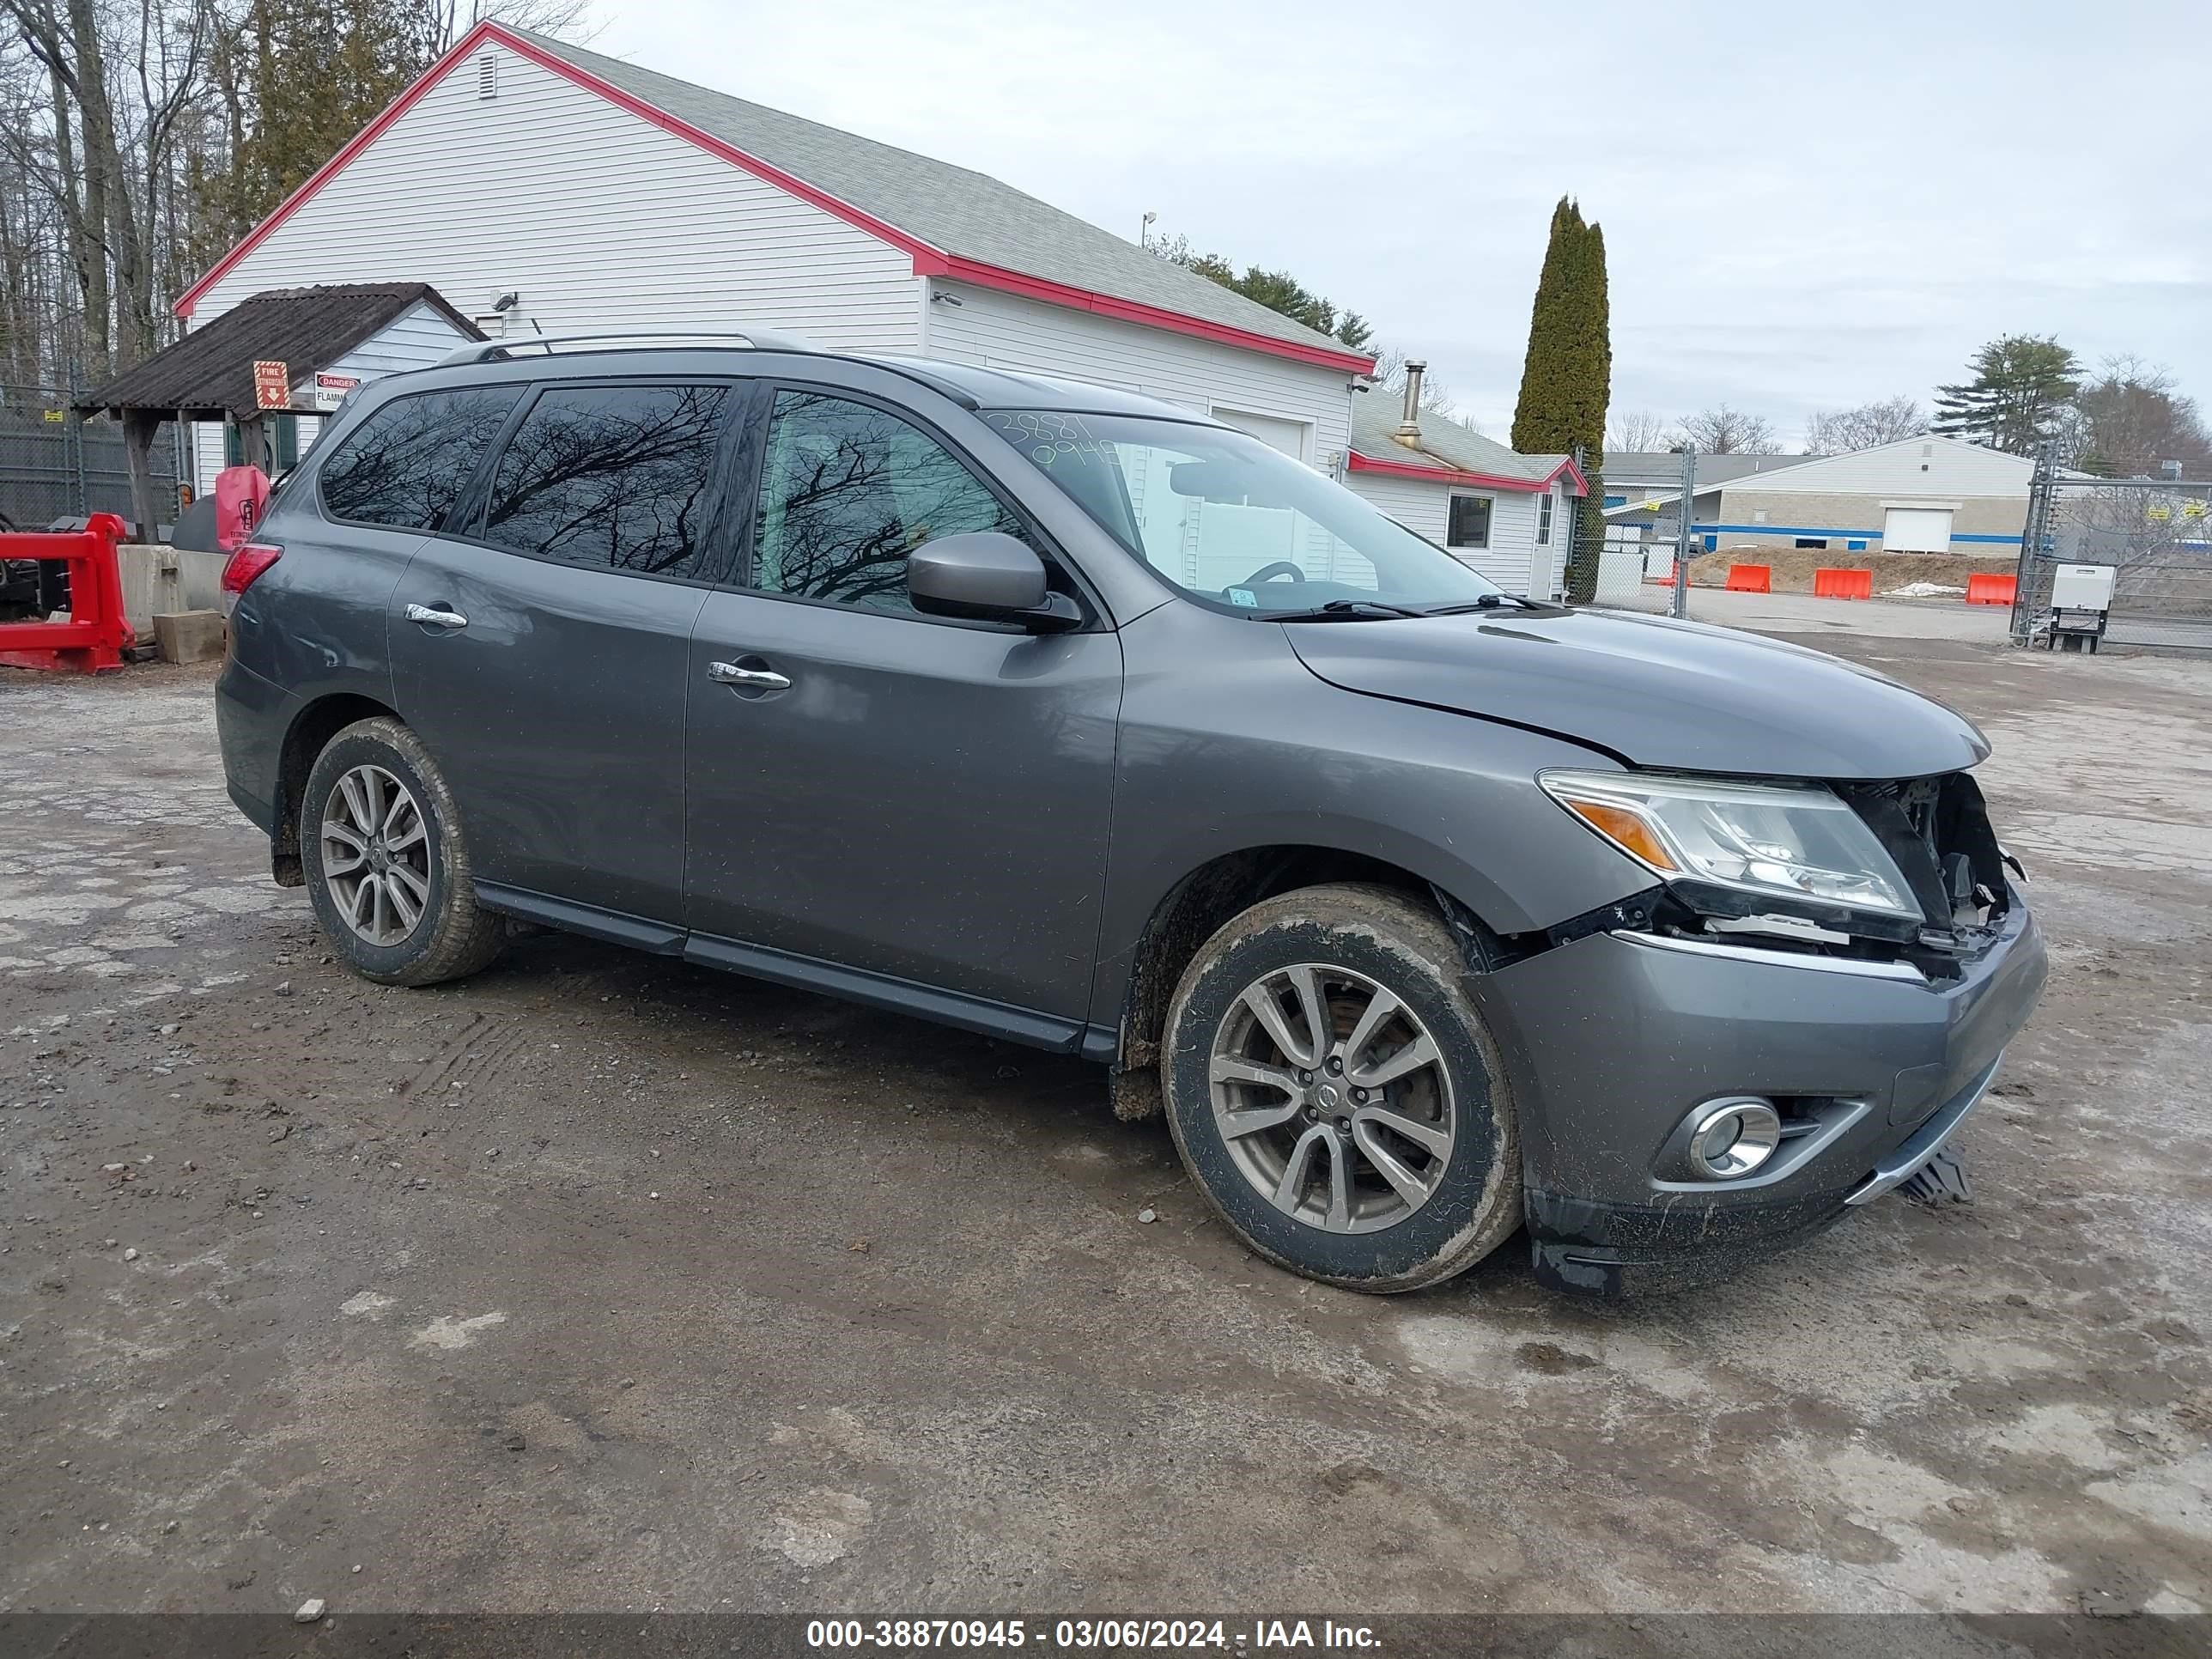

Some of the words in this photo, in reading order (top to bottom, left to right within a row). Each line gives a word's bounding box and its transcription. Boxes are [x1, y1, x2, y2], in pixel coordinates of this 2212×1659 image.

[261, 368, 280, 376] FIRE
[256, 378, 288, 386] EXTINGUISHER
[323, 378, 355, 387] DANGER
[317, 392, 344, 403] FLAMM
[987, 413, 1093, 444] 3887
